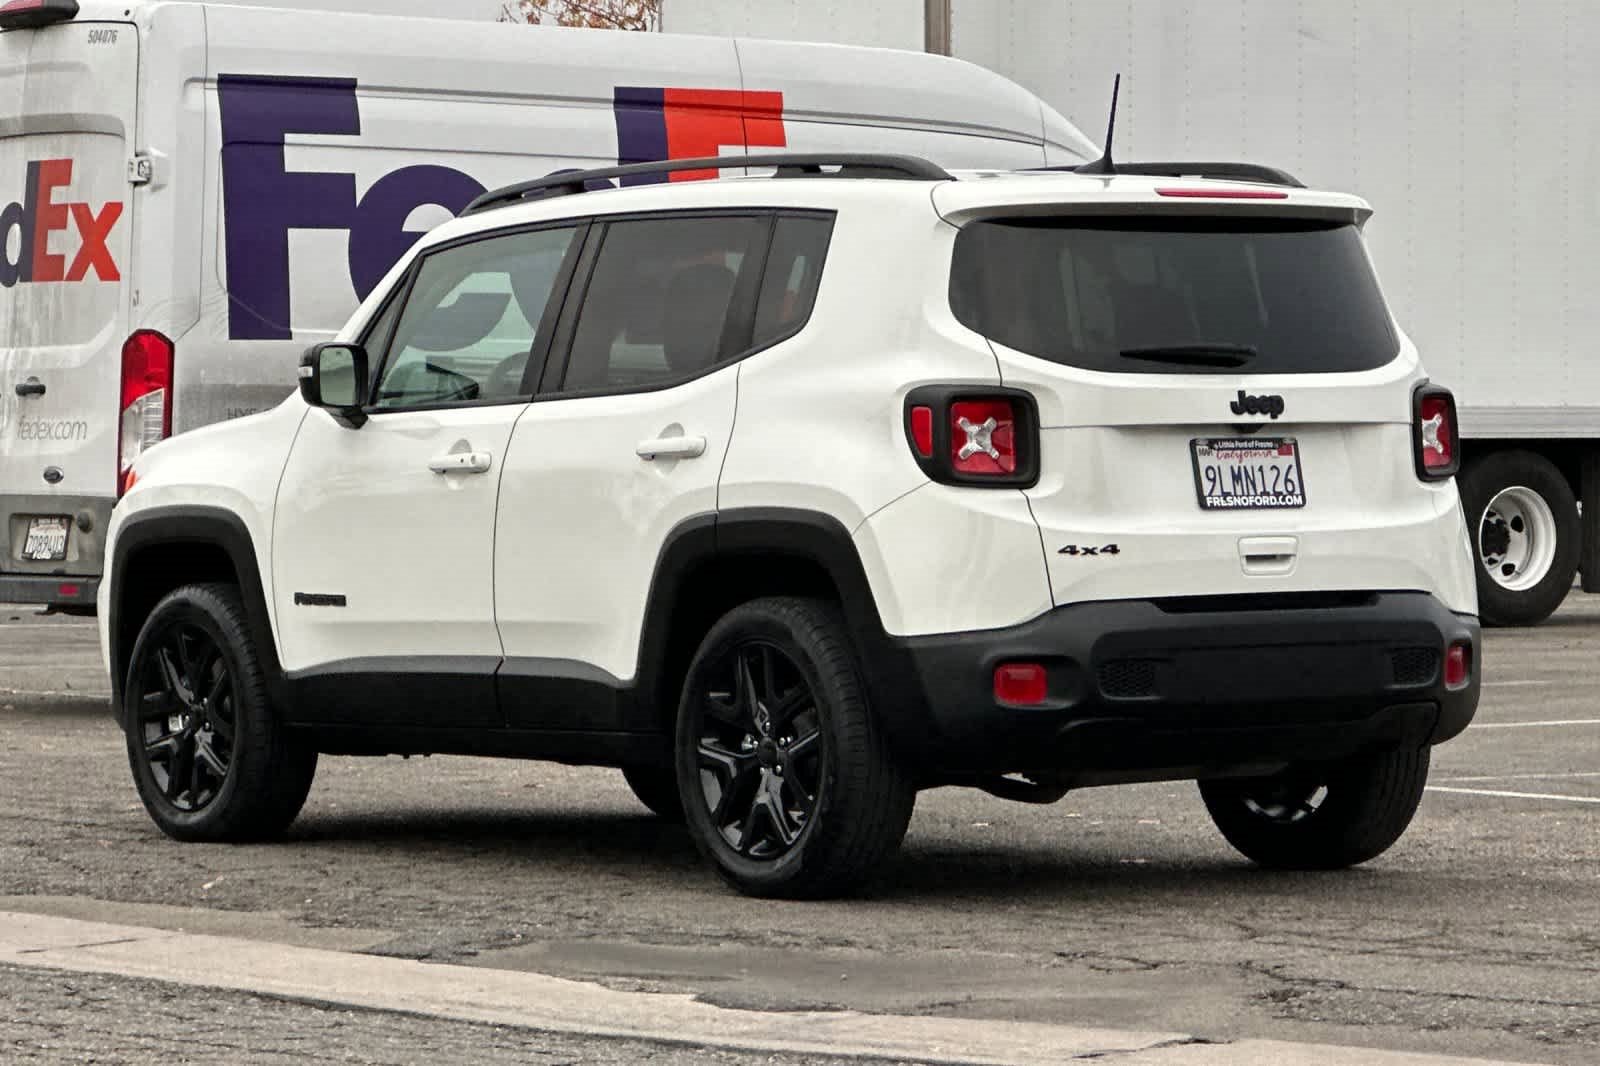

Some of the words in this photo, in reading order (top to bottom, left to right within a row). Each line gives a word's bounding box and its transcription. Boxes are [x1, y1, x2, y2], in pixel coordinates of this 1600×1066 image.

[0, 158, 123, 288] dEx
[1229, 389, 1285, 420] Jeep
[1216, 449, 1272, 464] California
[1205, 464, 1296, 496] 9LMN126
[1057, 544, 1121, 556] 4x4
